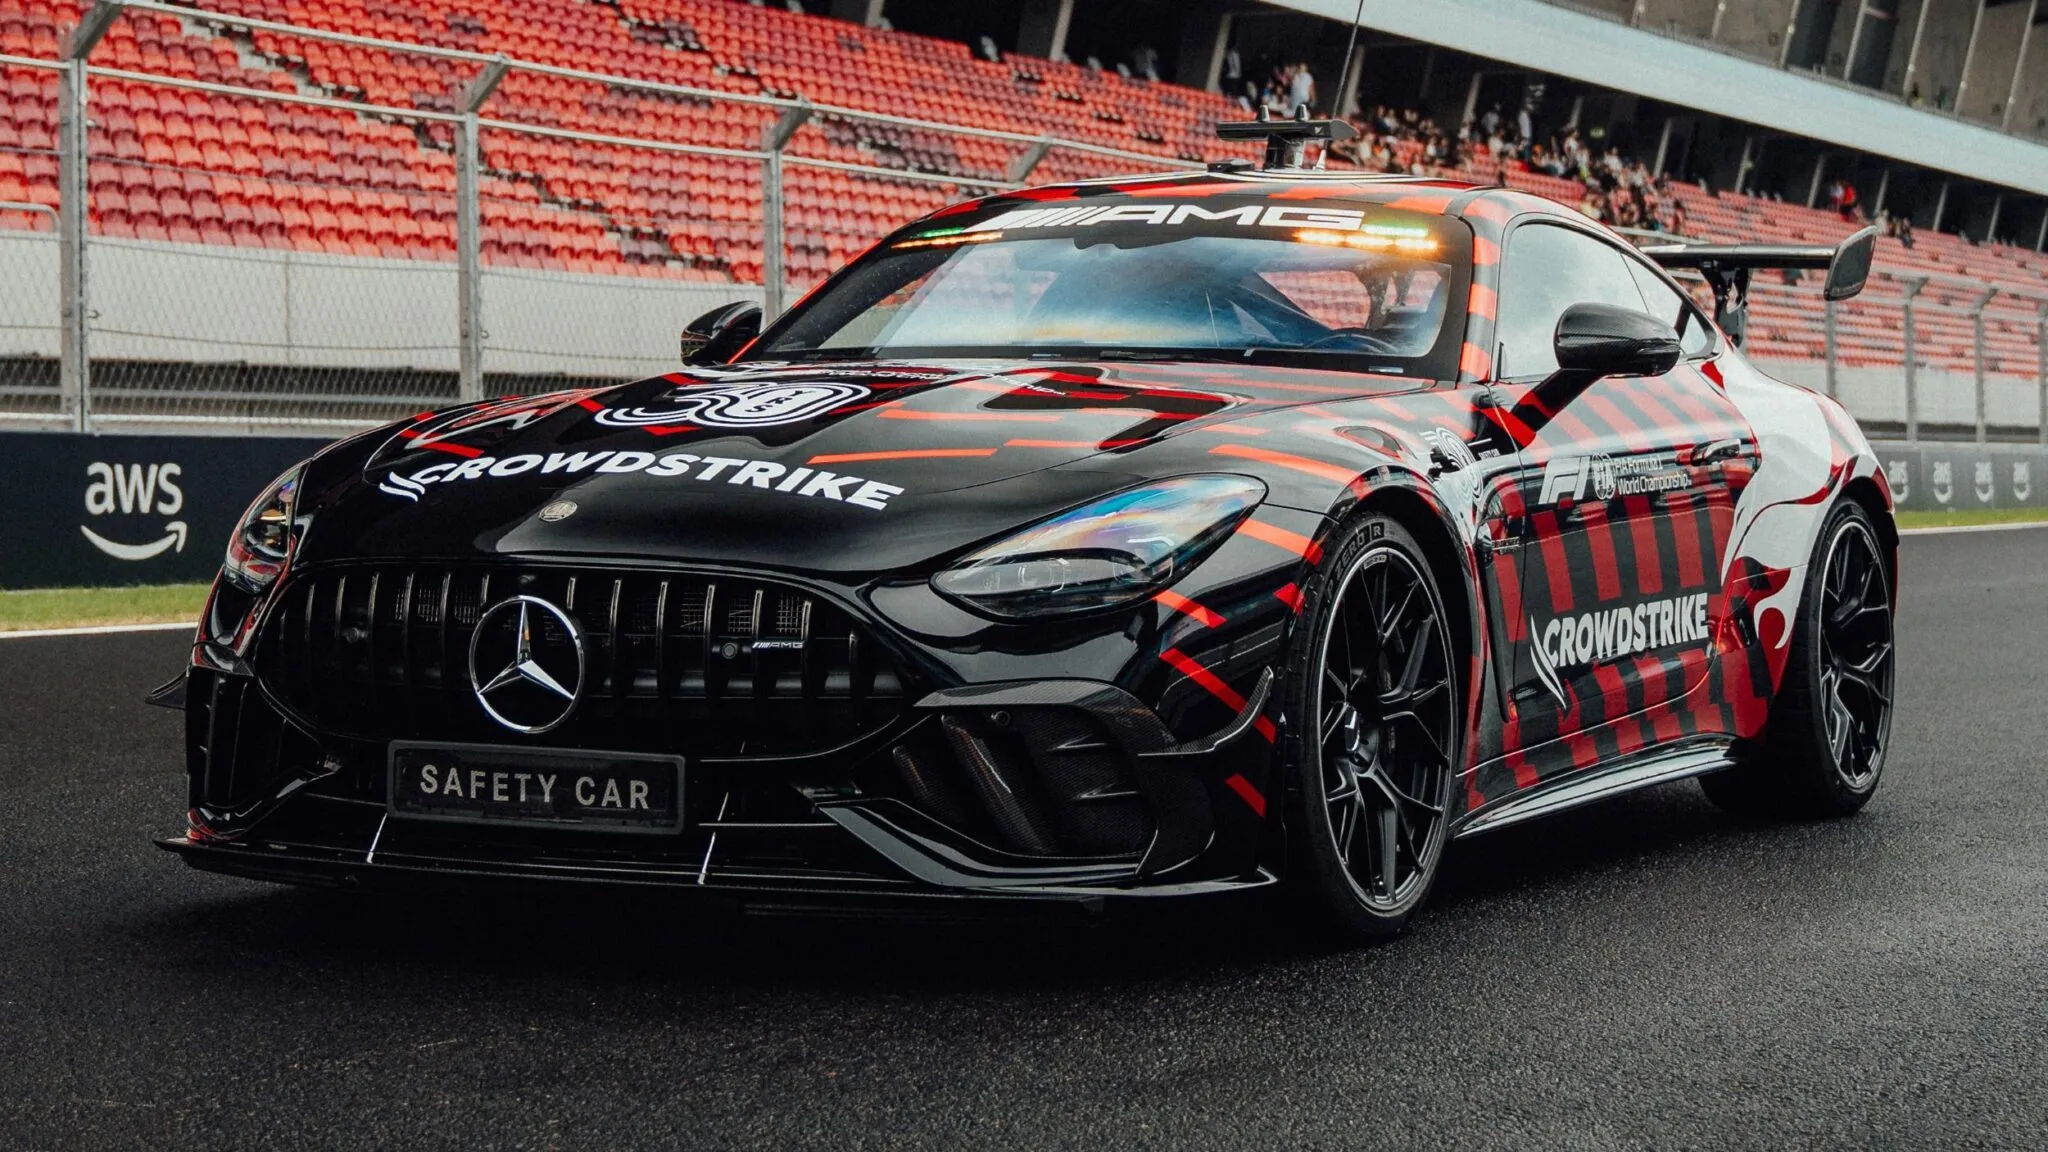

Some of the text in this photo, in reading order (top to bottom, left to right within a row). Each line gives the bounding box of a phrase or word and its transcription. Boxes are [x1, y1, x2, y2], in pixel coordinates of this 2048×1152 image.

[85, 461, 183, 516] aws
[409, 450, 905, 511] CROWDSTRIKE
[1538, 455, 1592, 505] F1
[1617, 477, 1641, 496] World
[1543, 591, 1710, 671] CROWDSTRIKE
[419, 763, 649, 809] SAFETY CAR
